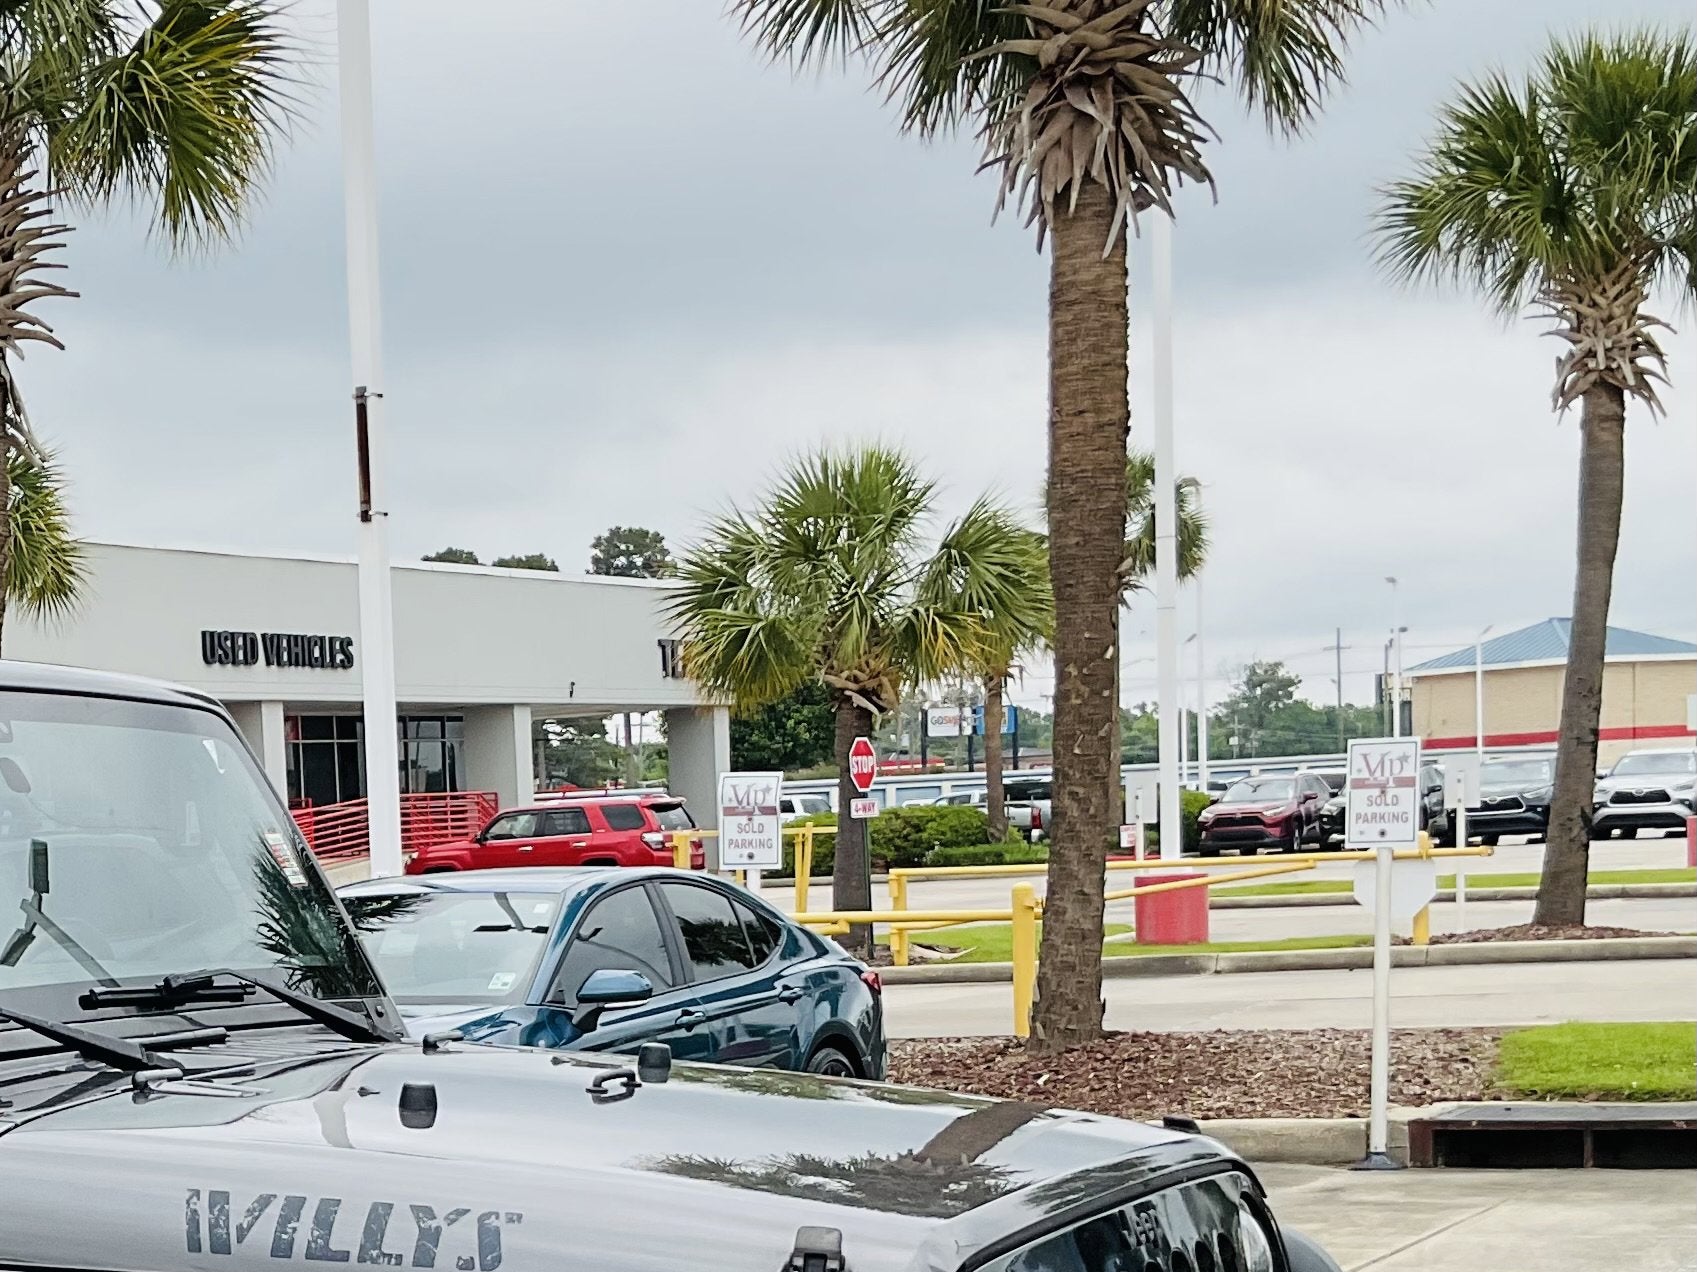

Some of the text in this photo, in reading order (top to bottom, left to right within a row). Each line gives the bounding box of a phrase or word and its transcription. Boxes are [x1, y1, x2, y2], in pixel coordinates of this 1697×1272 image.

[200, 630, 354, 669] USED VEHICLES
[851, 755, 874, 774] STOP
[1366, 794, 1399, 807] SOLD
[1355, 812, 1409, 825] PARKING
[737, 823, 764, 834] SOLD
[728, 838, 773, 850] PARKING
[185, 1188, 523, 1272] WILLYS
